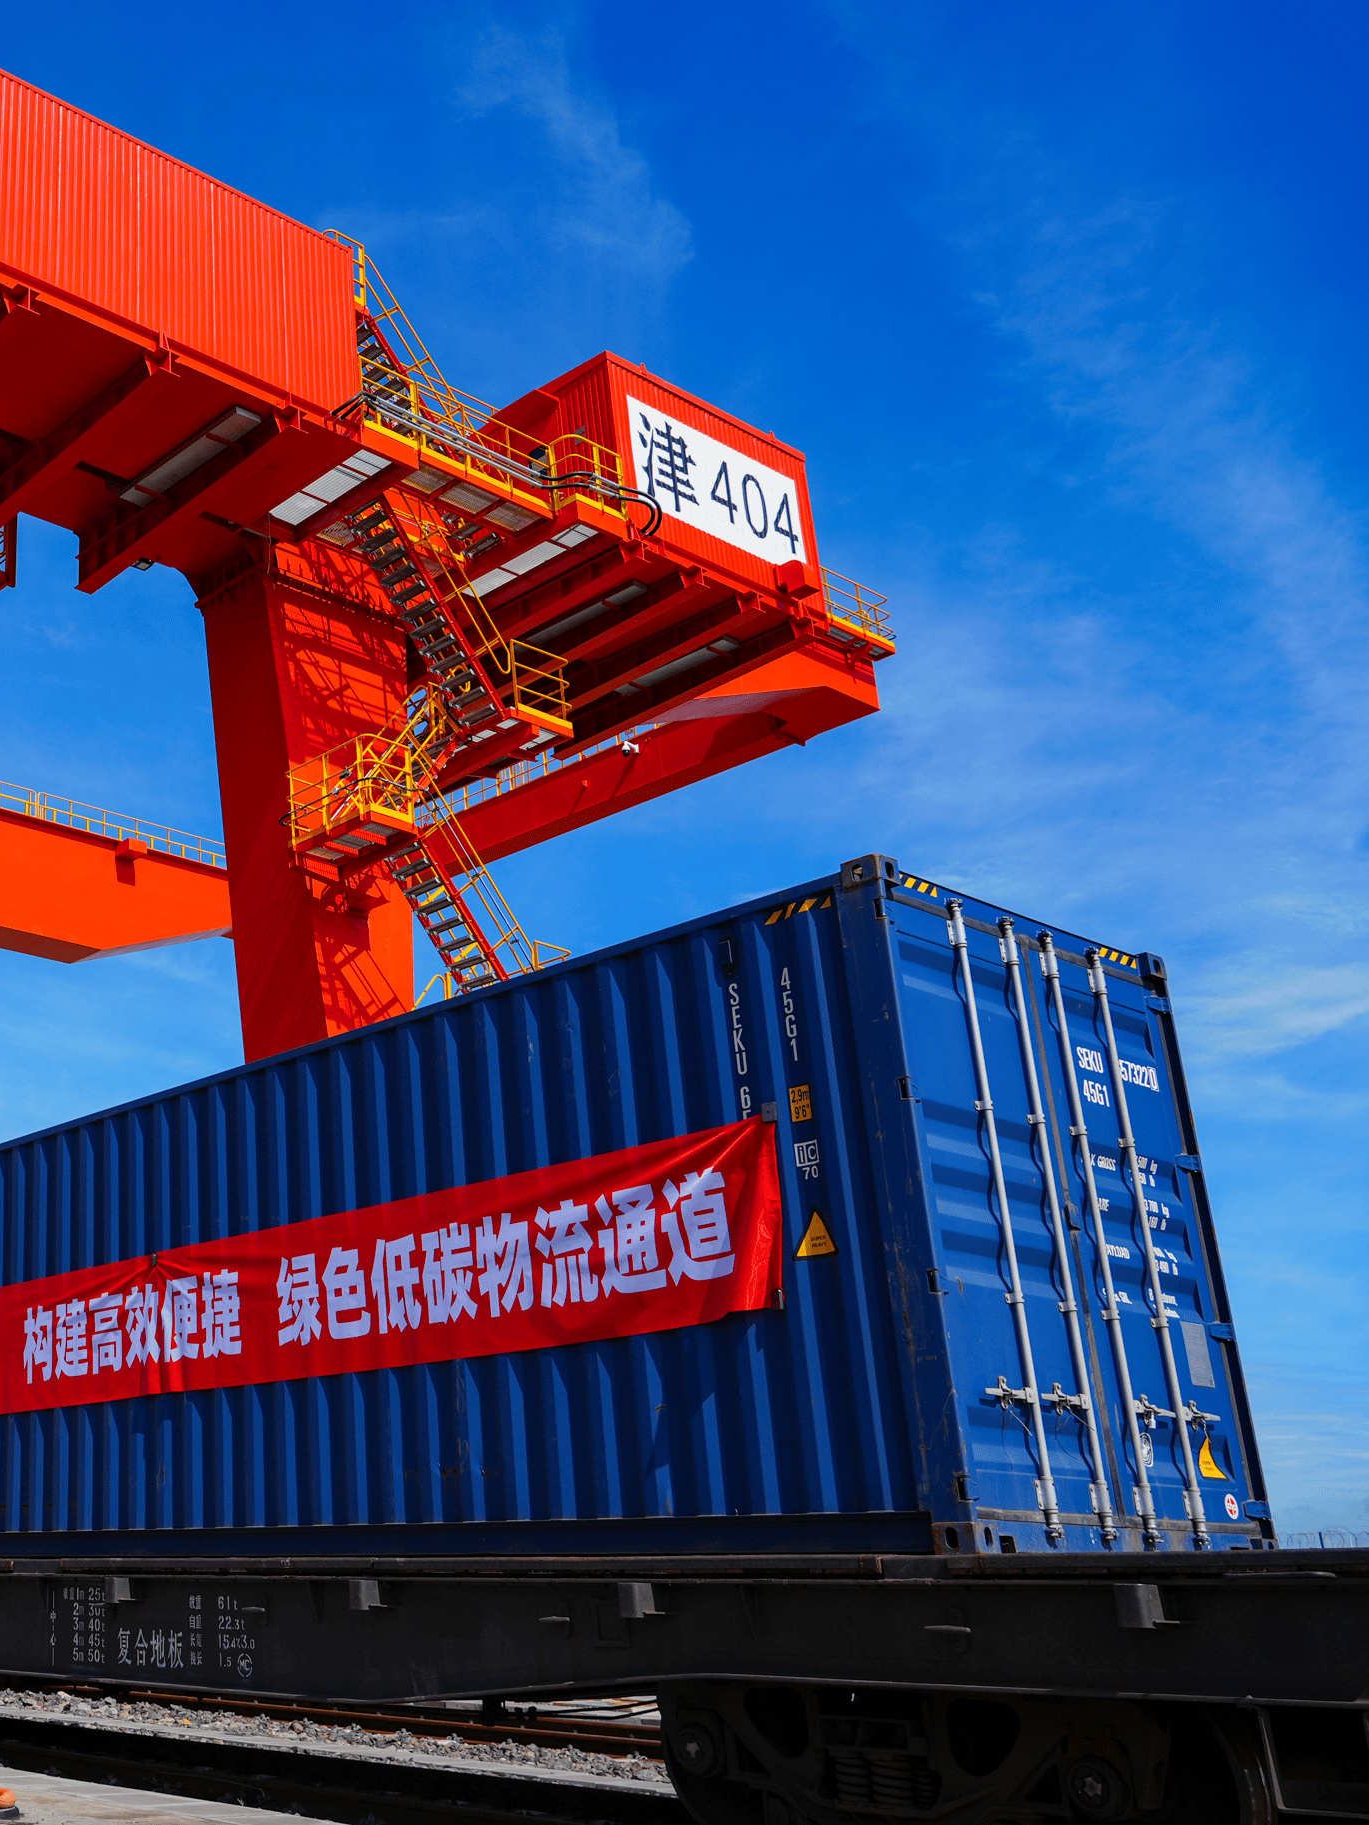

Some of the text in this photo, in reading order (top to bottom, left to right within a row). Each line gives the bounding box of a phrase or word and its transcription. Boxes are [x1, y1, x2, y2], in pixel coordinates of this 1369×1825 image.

[780, 967, 798, 1062] 45G1
[729, 983, 747, 1076] SEKU
[1076, 1046, 1160, 1092] SEKU 573220
[1083, 1079, 1110, 1107] 45G1
[1097, 1155, 1116, 1171] GROSS
[802, 1165, 819, 1180] 70
[1105, 1244, 1130, 1260] AYLOAD
[23, 1268, 243, 1385] 构建高效便捷
[277, 1166, 736, 1347] 绿色低碳物流通道
[88, 1587, 105, 1602] 25t
[73, 1602, 85, 1616] 2m
[72, 1617, 105, 1633] 3m 40t
[189, 1614, 202, 1629] 自重
[72, 1632, 105, 1648] 4m 45t
[117, 1626, 185, 1669] 复合地板
[72, 1647, 105, 1664] 5m 50t
